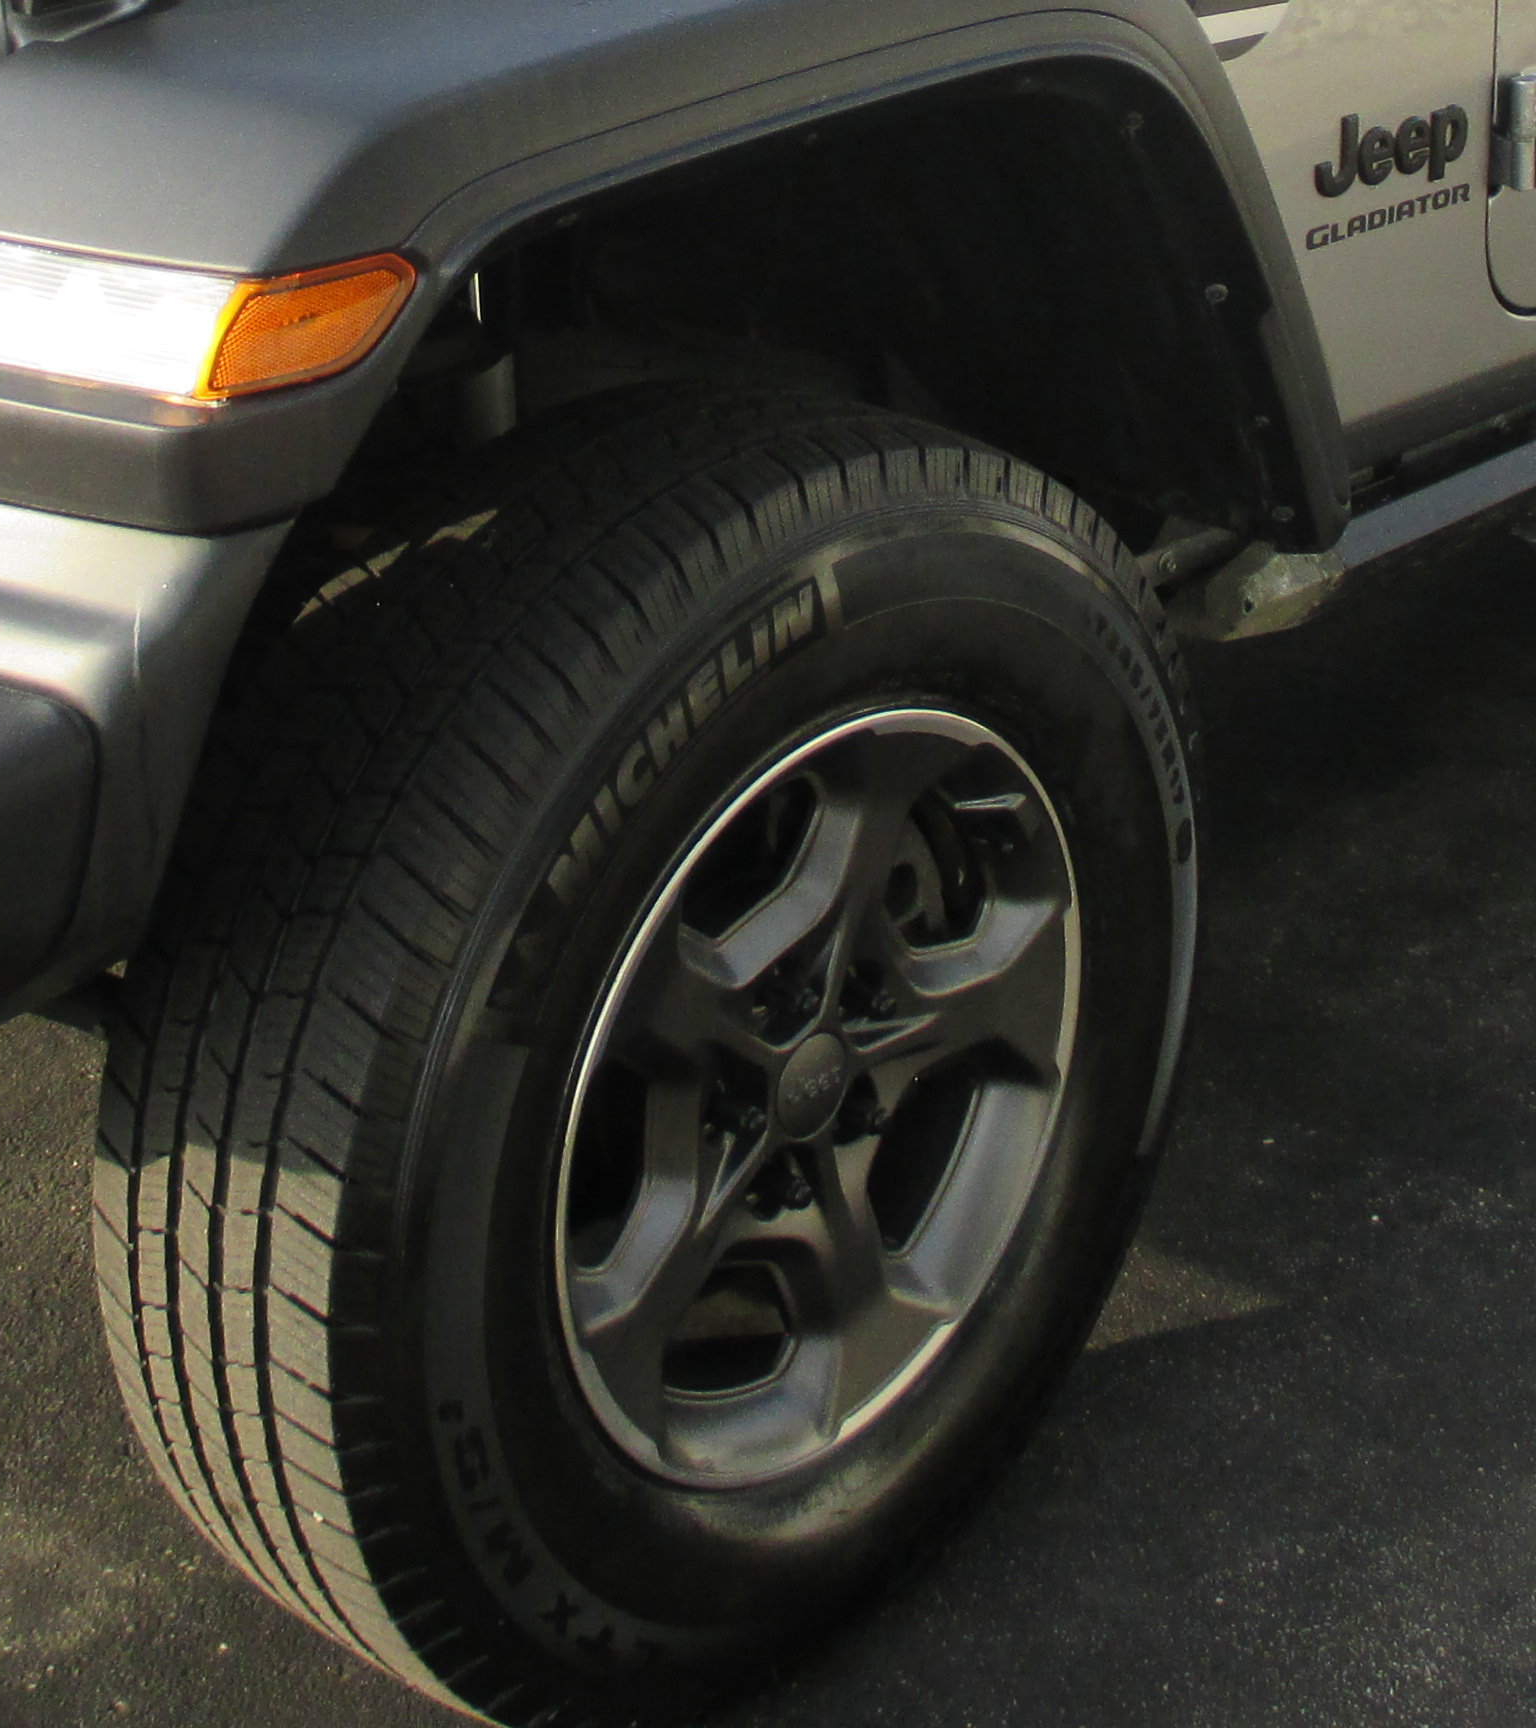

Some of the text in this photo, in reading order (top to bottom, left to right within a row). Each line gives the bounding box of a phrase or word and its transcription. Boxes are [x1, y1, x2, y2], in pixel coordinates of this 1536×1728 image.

[1314, 103, 1469, 198] Jeep
[1305, 182, 1471, 251] GLADIATOR
[547, 582, 815, 906] MICHELIN
